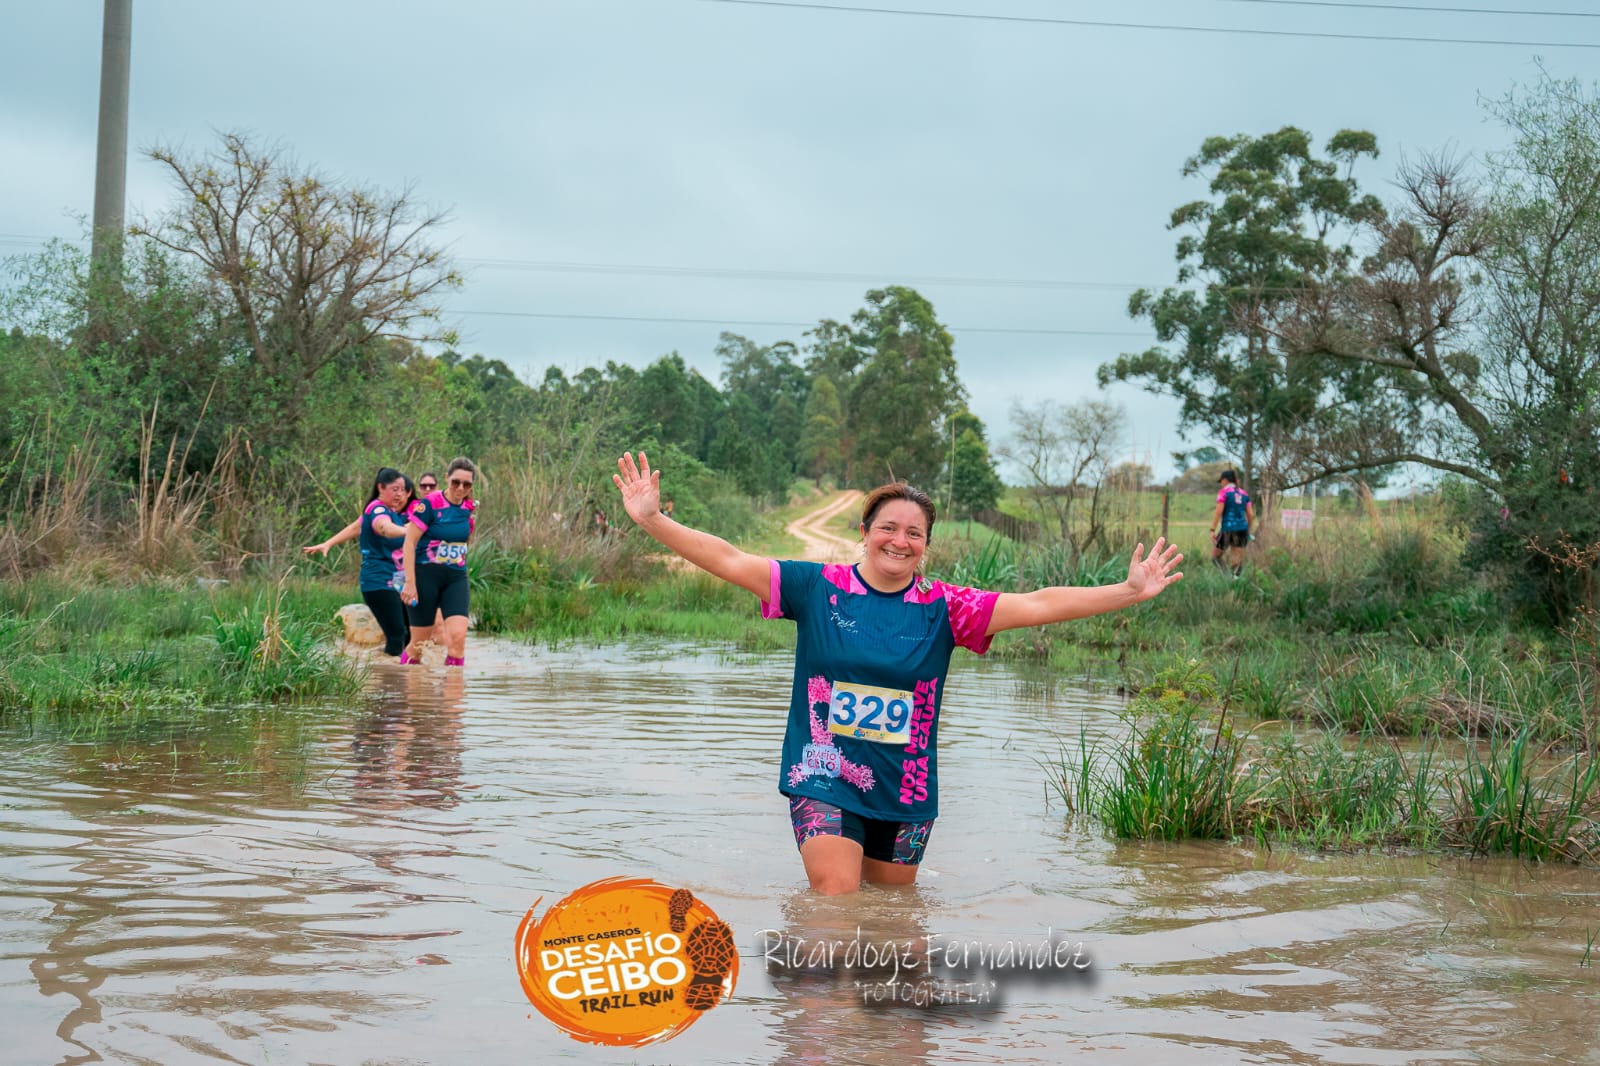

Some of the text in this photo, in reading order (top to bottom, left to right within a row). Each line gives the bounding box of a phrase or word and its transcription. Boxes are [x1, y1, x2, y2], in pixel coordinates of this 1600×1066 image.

[833, 691, 909, 733] 329
[899, 679, 929, 805] NOS MUEVE
[914, 677, 939, 802] UNA CAUSA
